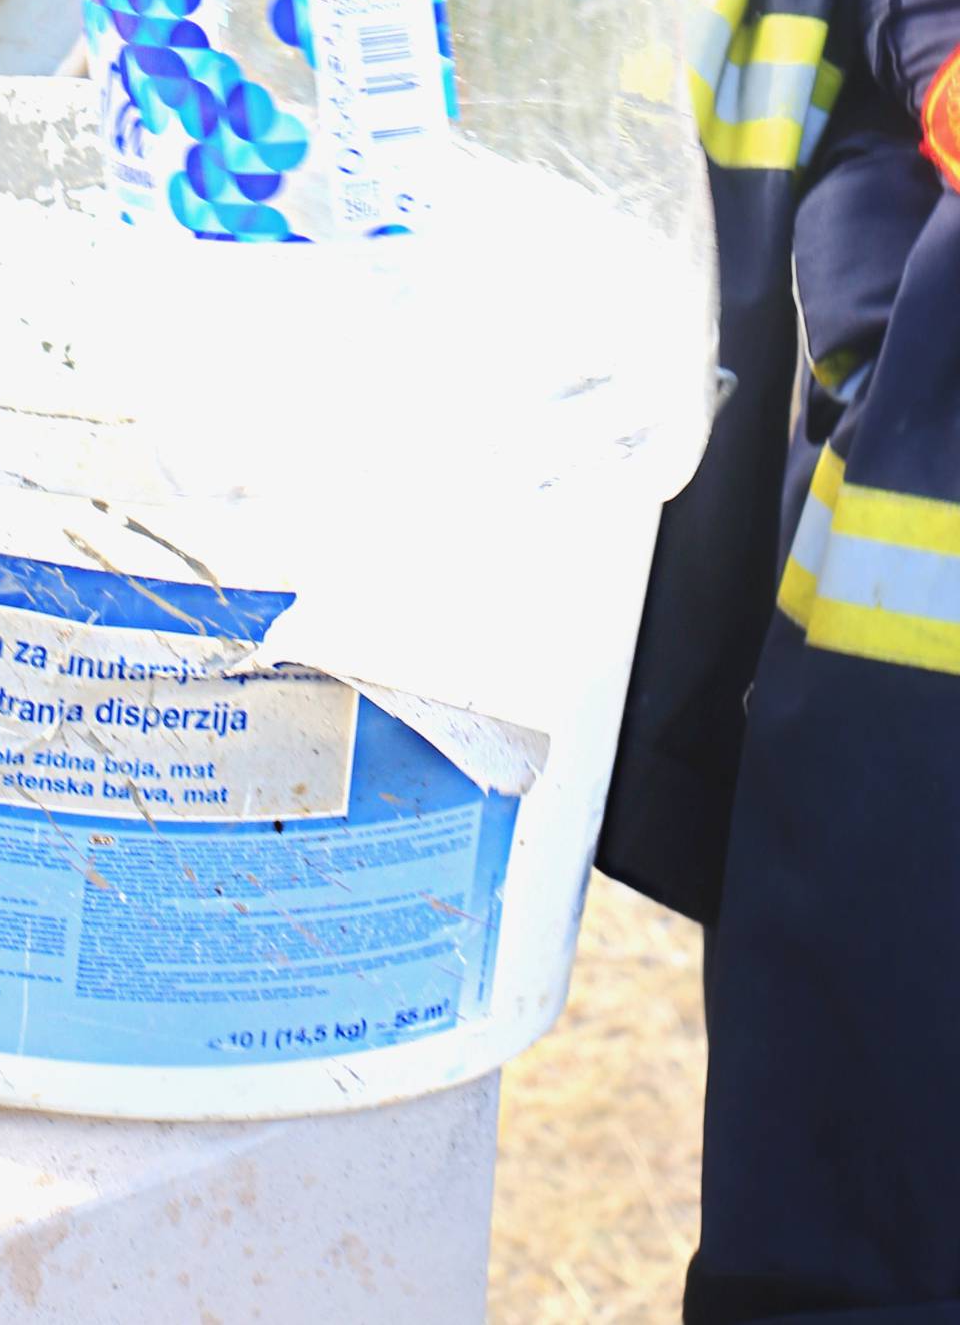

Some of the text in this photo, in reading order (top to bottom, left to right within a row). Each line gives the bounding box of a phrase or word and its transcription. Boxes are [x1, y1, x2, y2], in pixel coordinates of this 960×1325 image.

[13, 639, 48, 670] za
[95, 696, 248, 736] disperzija
[33, 749, 96, 772] zidna
[103, 753, 161, 780] boja,
[169, 760, 216, 779] mat
[2, 770, 94, 797] stenska
[102, 778, 174, 805] bava,
[183, 786, 228, 804] mat
[275, 1024, 328, 1051] (14,5
[334, 1016, 368, 1044] kg)
